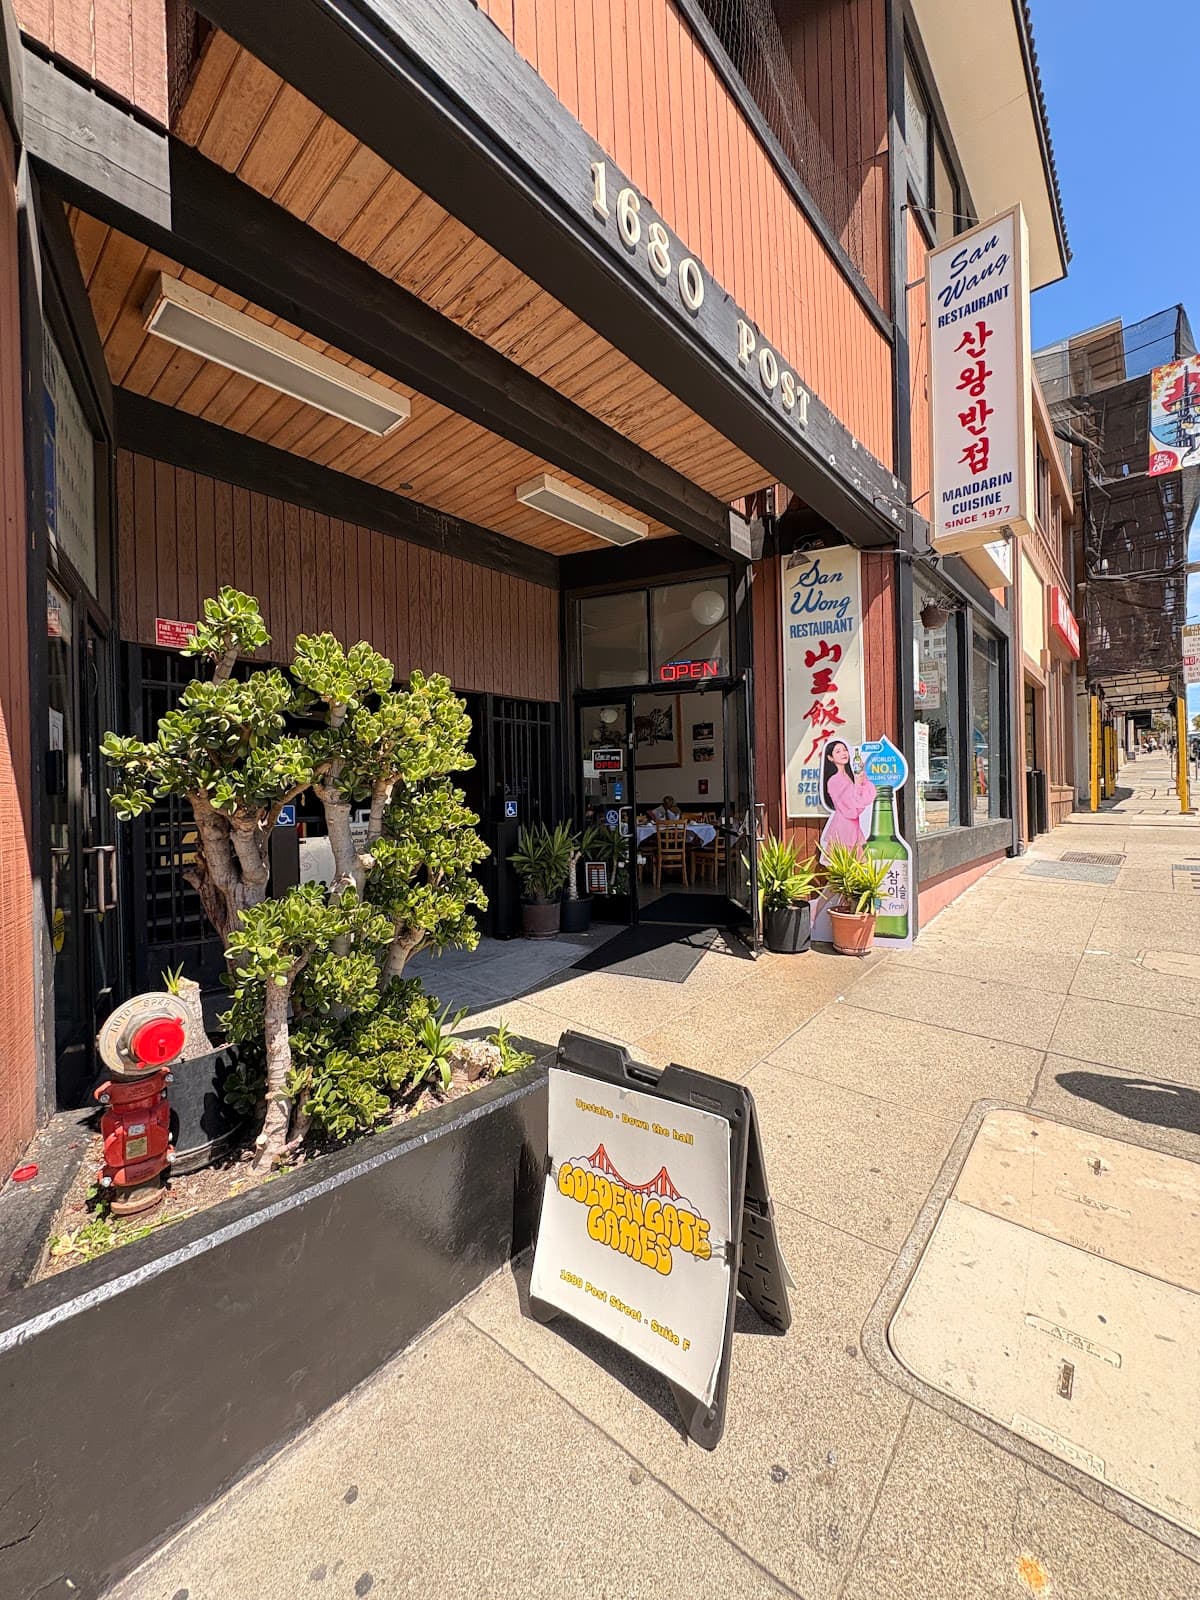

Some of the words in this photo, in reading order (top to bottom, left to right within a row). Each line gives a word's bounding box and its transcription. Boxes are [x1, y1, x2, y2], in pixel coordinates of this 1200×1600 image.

[950, 235, 999, 279] San
[590, 161, 705, 311] 1680
[737, 318, 811, 426] POST
[938, 253, 1010, 307] Wang
[938, 284, 1010, 328] RESTAURANT
[954, 321, 994, 475] 산왕반점
[942, 471, 1013, 502] MANDARIN
[945, 514, 978, 529] SINCE
[981, 505, 1011, 520] 1977
[952, 491, 1002, 515] CUISINE
[791, 559, 844, 590] San
[790, 588, 852, 619] Wong
[790, 617, 853, 639] RESTAURANT
[660, 661, 718, 681] OPEN
[595, 761, 620, 769] OPEN
[871, 763, 897, 774] NO.1
[888, 902, 905, 911] fresh
[111, 1009, 132, 1033] AUTO
[575, 1098, 614, 1118] Upstairs
[621, 1112, 650, 1131] Down
[652, 1122, 670, 1137] the
[672, 1129, 694, 1146] hall
[558, 1162, 645, 1228] GOLDEN
[643, 1198, 712, 1260] GATE
[587, 1204, 673, 1276] GAMES
[585, 1281, 607, 1303] Post
[609, 1296, 642, 1322] Street
[650, 1319, 679, 1345] Suite
[682, 1338, 691, 1352] F
